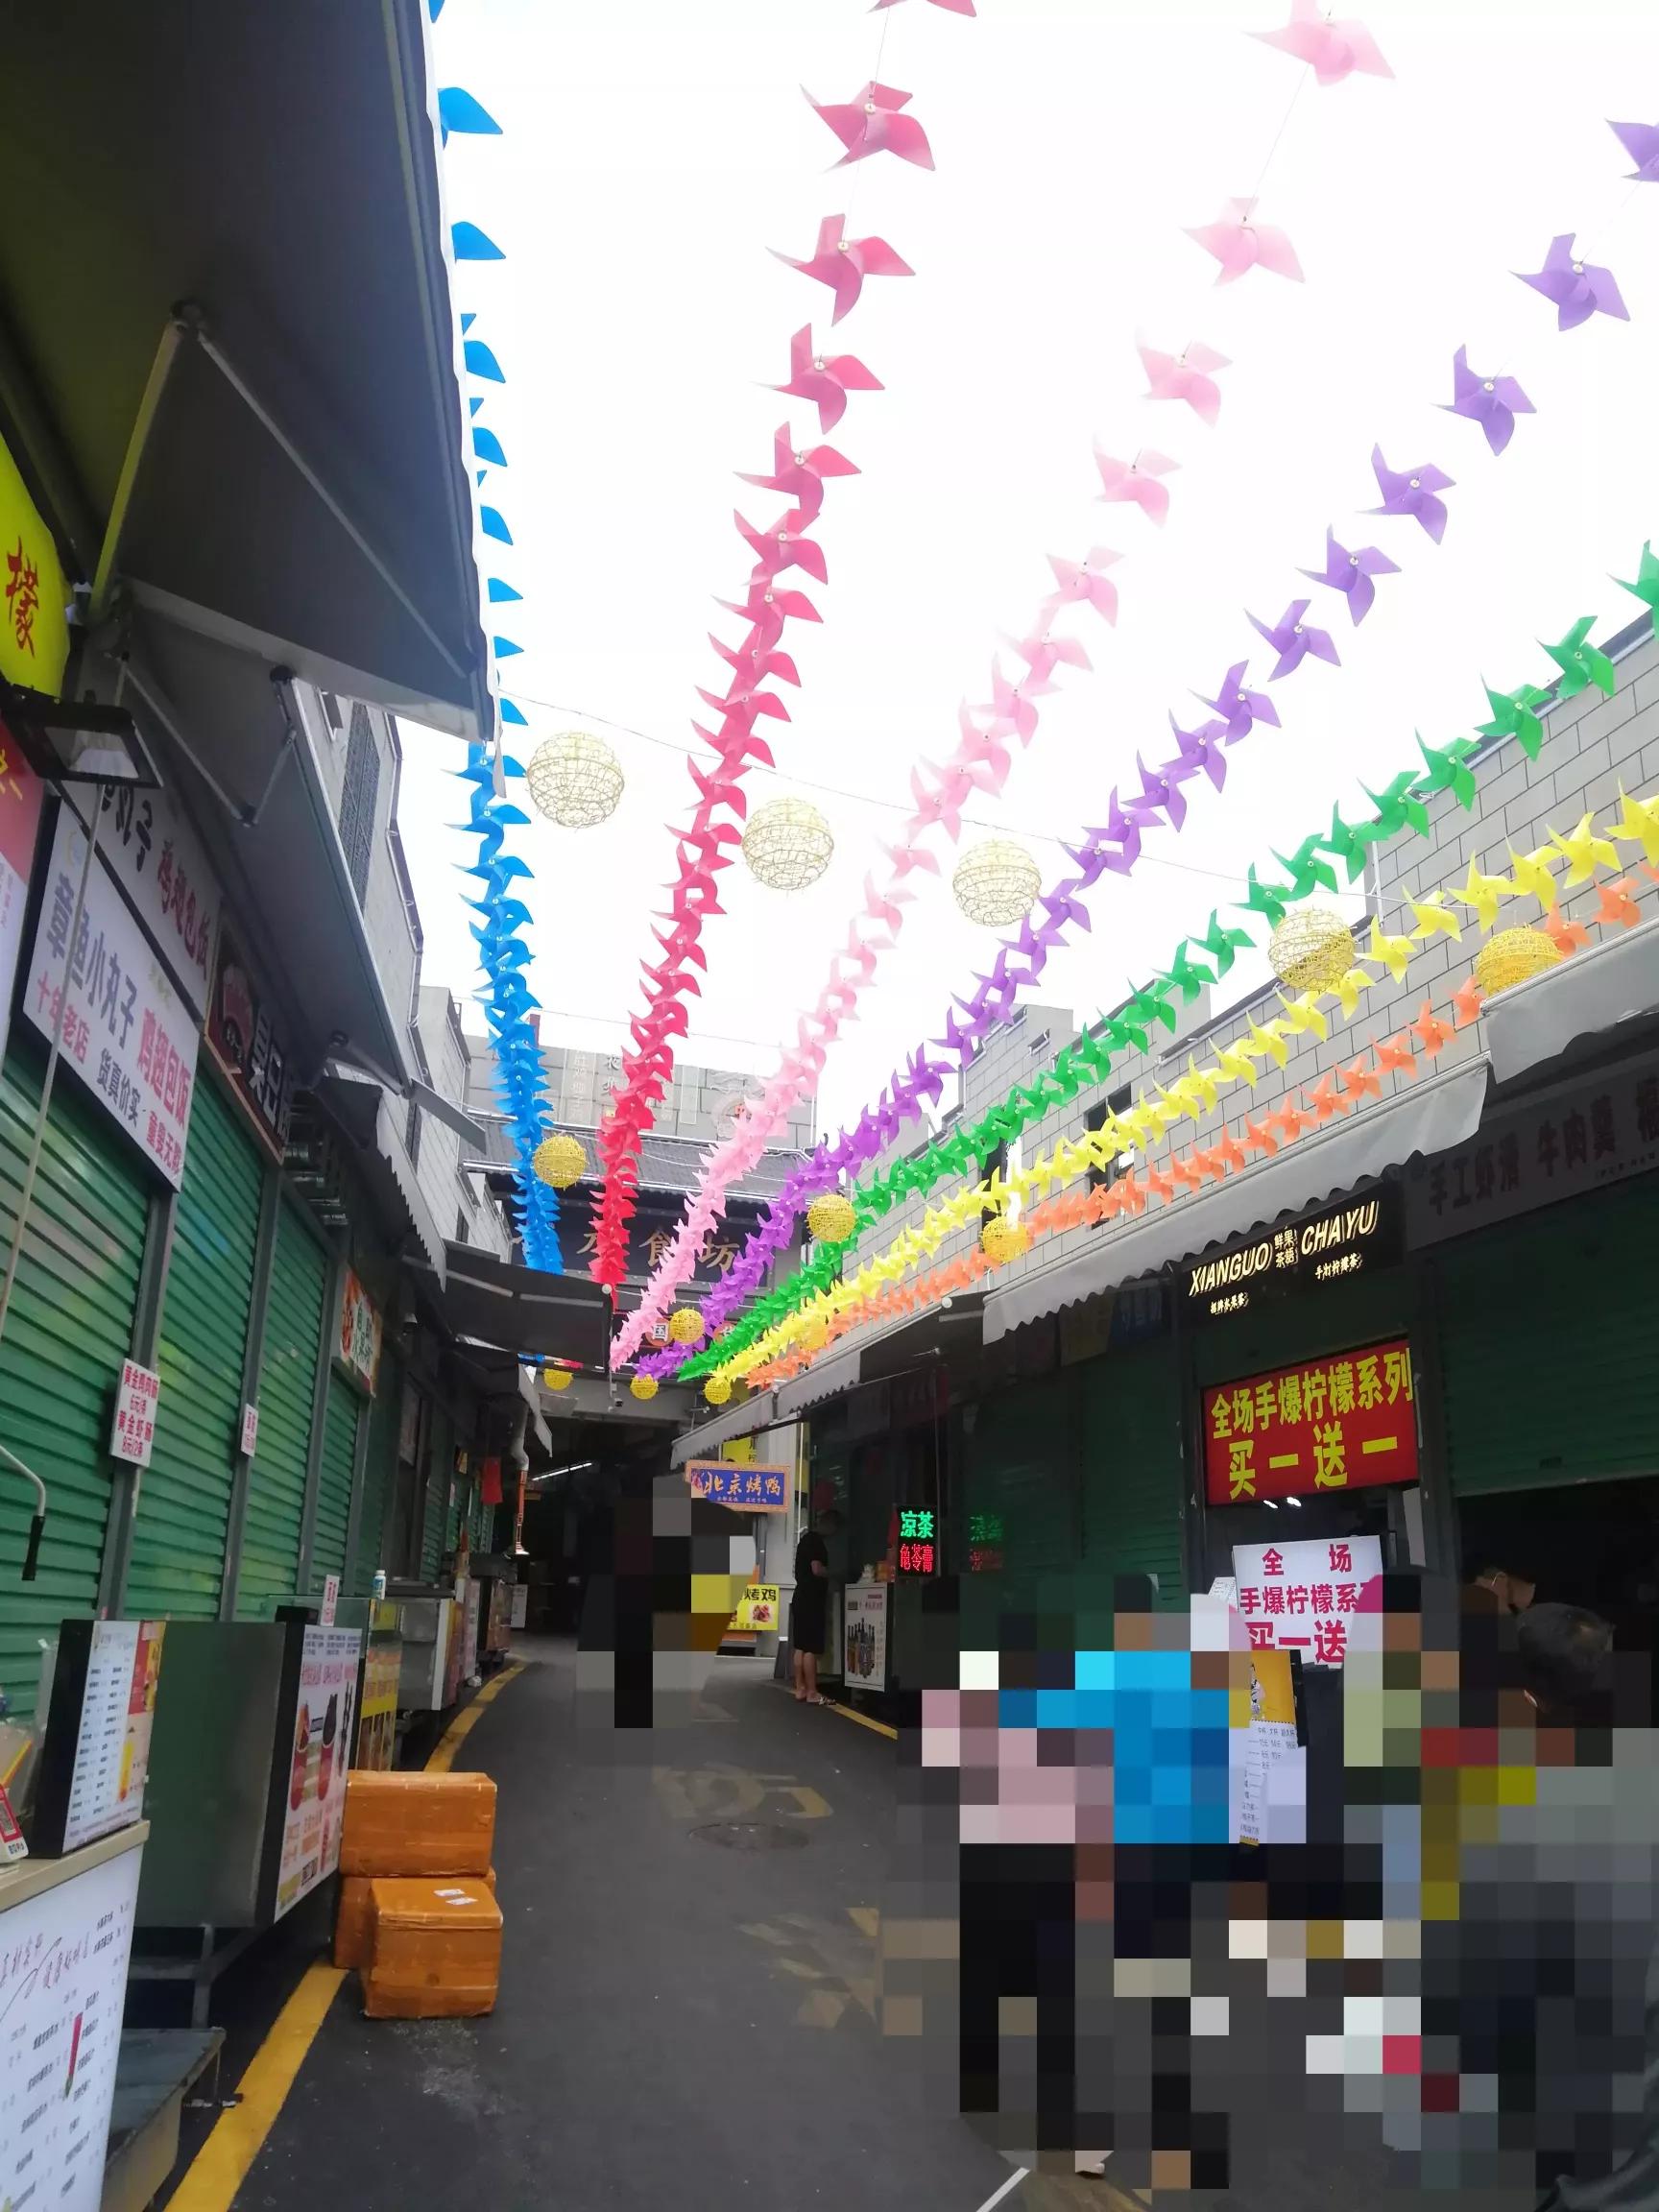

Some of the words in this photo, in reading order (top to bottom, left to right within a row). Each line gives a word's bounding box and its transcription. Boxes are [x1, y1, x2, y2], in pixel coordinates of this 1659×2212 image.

[96, 1046, 140, 1129] 货真价实
[1301, 1200, 1380, 1255] CHAYU
[1189, 1242, 1274, 1296] XIANGUO
[1211, 1347, 1414, 1440] 全场手爆柠檬系列
[1229, 1420, 1399, 1501] 买一送一
[703, 1471, 781, 1497] 北京烤鸭
[900, 1510, 934, 1538] 凉茶
[900, 1544, 934, 1573] 龟苓膏
[744, 1588, 777, 1601] 烤鸡
[1239, 1583, 1365, 1616] 手爆柠檬系
